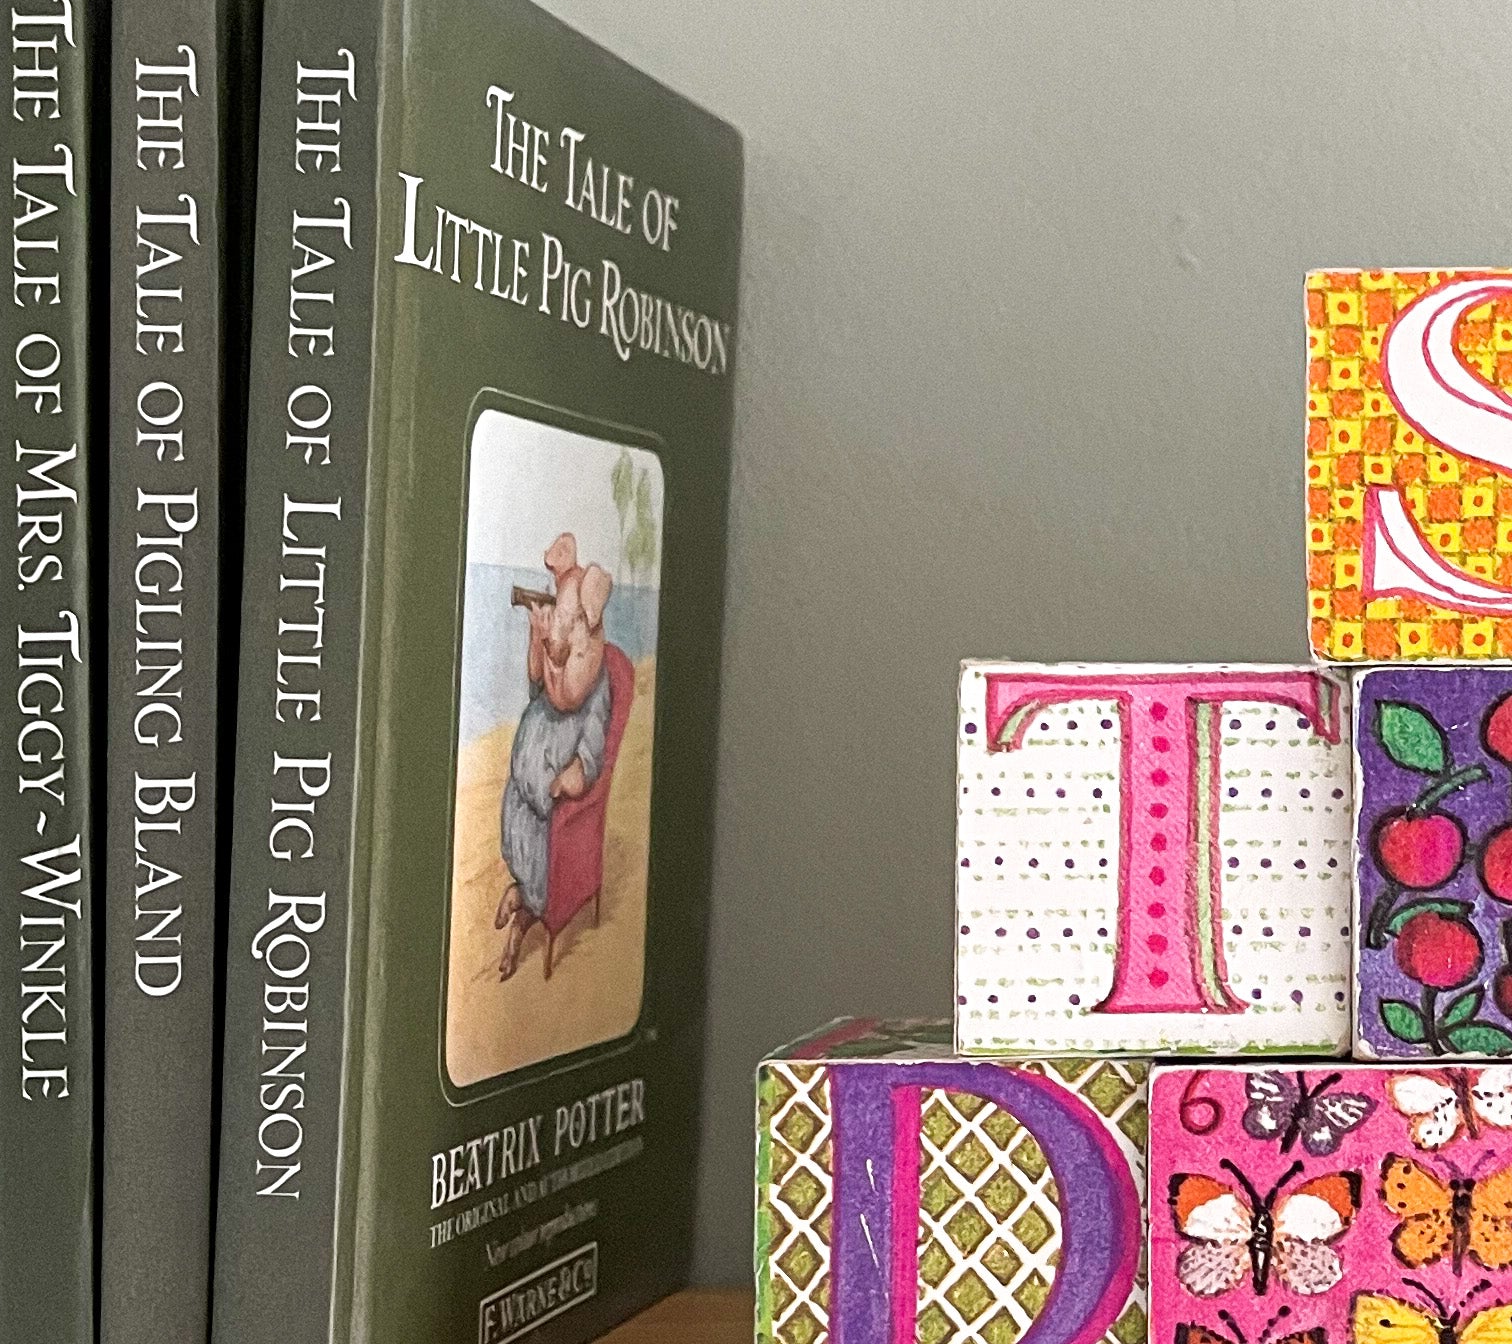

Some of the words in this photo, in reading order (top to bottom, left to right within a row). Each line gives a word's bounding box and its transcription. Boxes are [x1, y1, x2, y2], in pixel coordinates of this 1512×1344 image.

[134, 44, 200, 172] THE
[294, 47, 358, 175] THE
[486, 85, 551, 193] THE
[560, 127, 635, 236] TALE
[641, 188, 681, 253] OF
[11, 144, 78, 308] TALE
[134, 193, 201, 357] TALE
[287, 196, 354, 360] TALE
[394, 170, 531, 306] LITTLE
[537, 232, 592, 329] PIG
[600, 259, 732, 375] ROBINSON
[14, 332, 64, 416] OF
[136, 381, 185, 463] OF
[284, 384, 333, 466] OF
[14, 441, 80, 592] MRS.
[134, 486, 199, 748] PIGLING
[275, 493, 342, 725] LITTLE
[133, 771, 197, 998] BLAND
[268, 750, 332, 864] PIG
[985, 672, 1341, 1016] T
[250, 886, 327, 1202] ROBINSON
[1179, 1068, 1226, 1137] 6
[430, 1115, 545, 1210] BEATRIX
[554, 1078, 645, 1156] POTTER
[430, 1220, 455, 1249] THE
